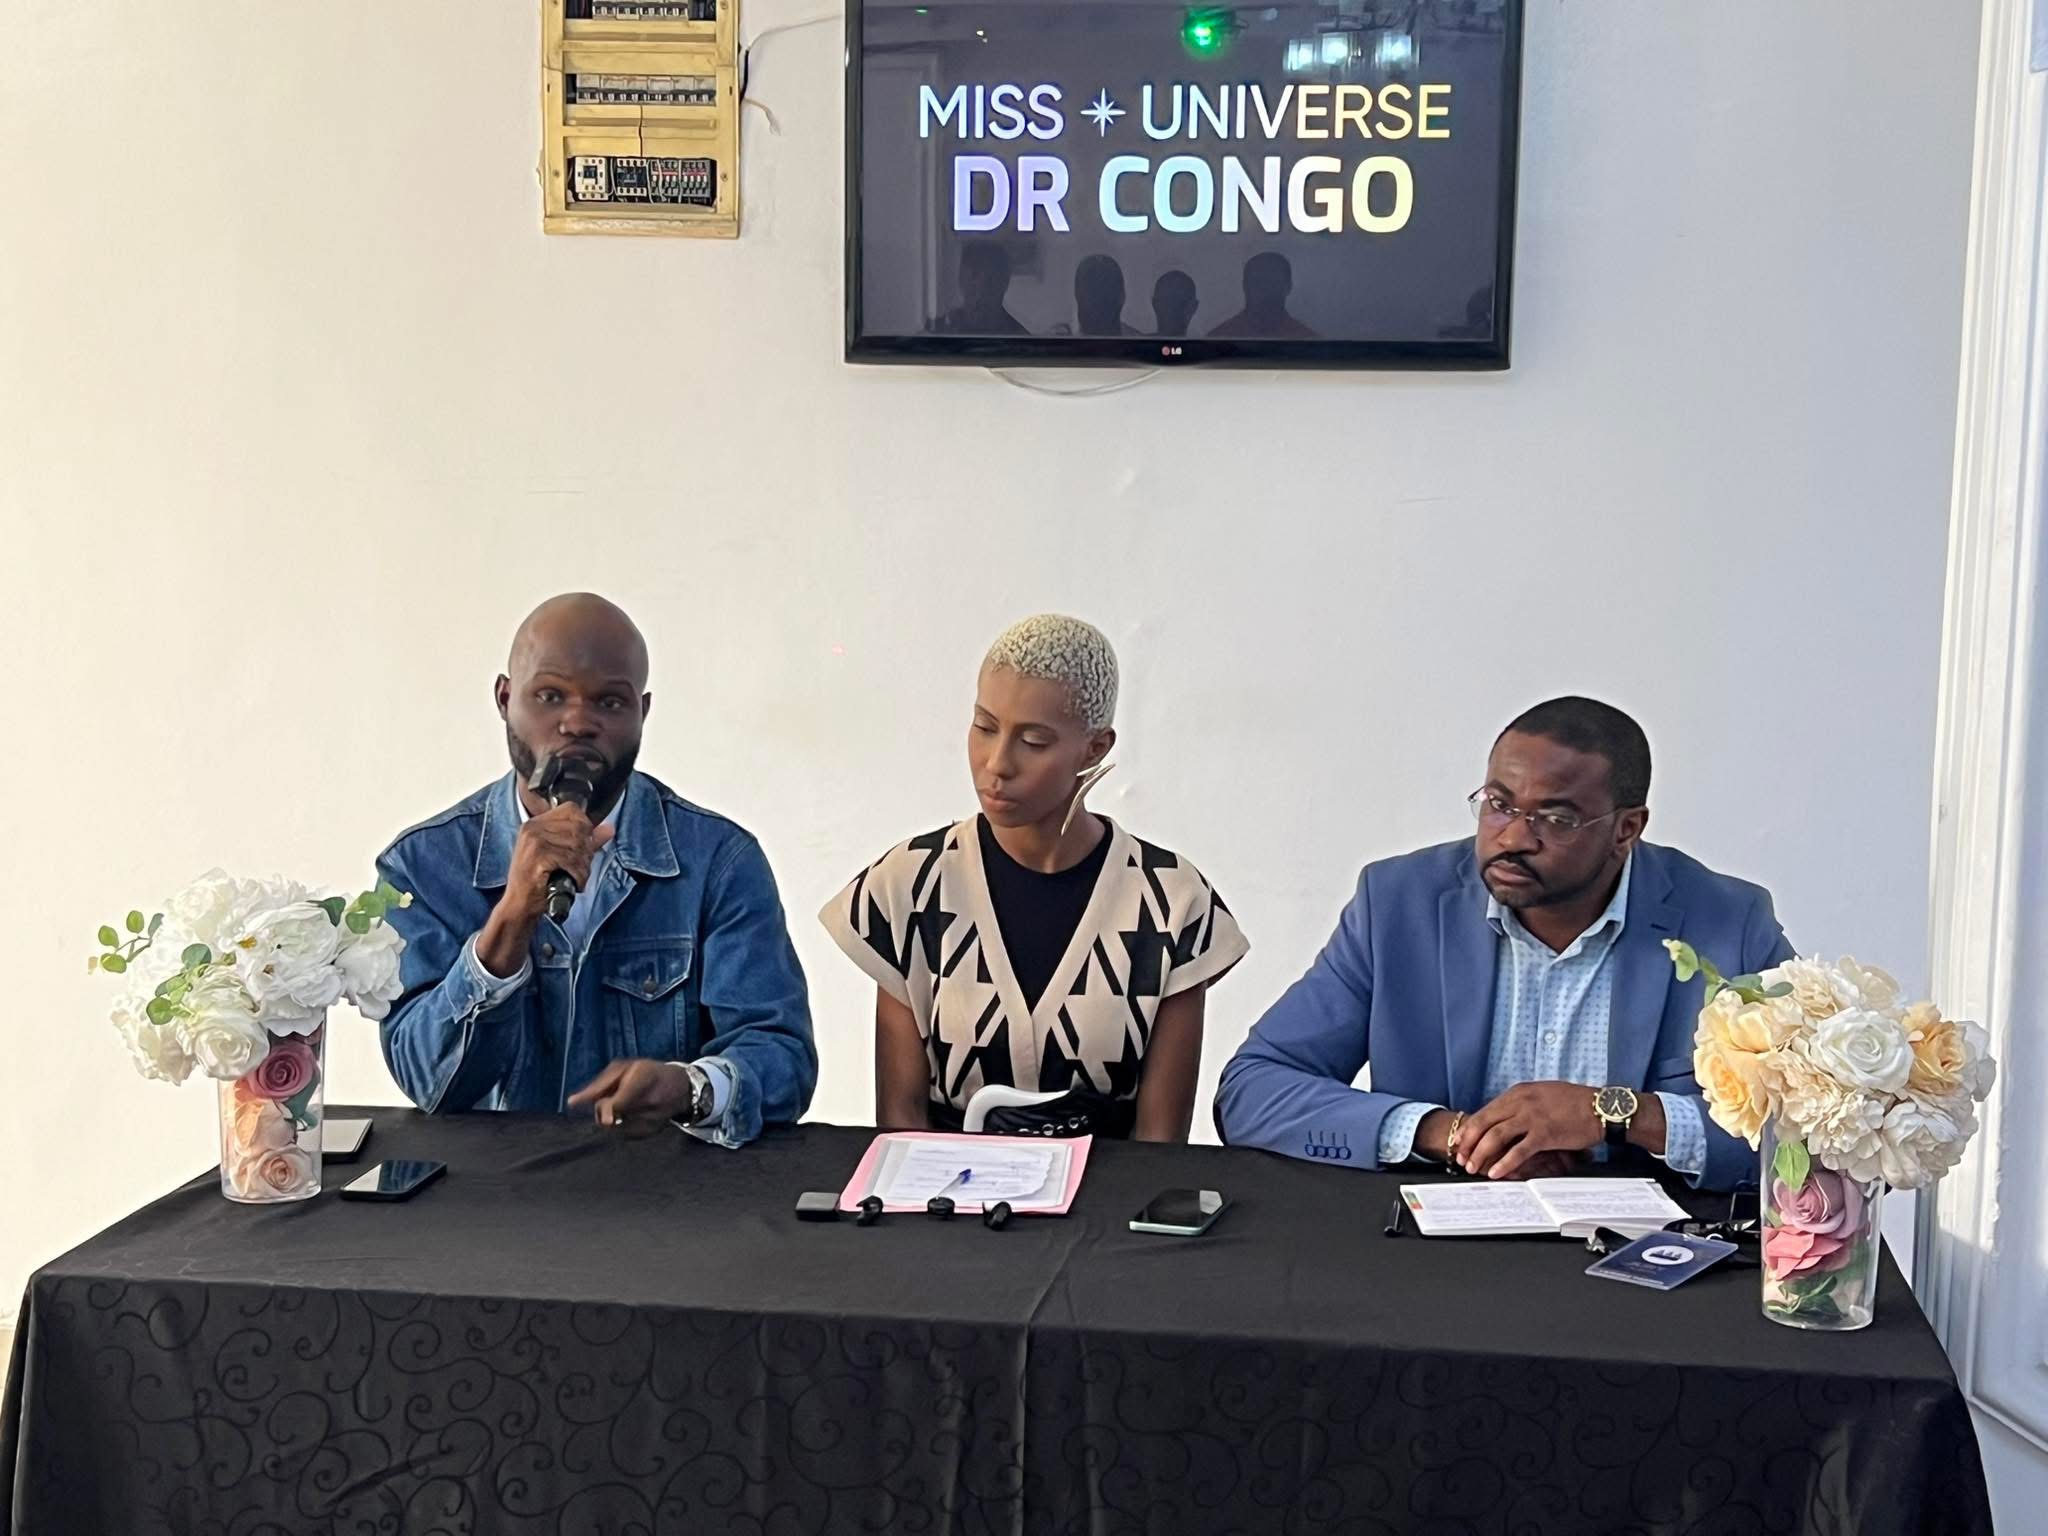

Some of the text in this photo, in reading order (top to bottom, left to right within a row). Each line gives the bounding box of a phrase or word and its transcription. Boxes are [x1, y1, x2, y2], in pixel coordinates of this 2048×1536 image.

[919, 83, 1452, 140] MISS UNIVERSE
[953, 155, 1414, 233] DR CONGO
